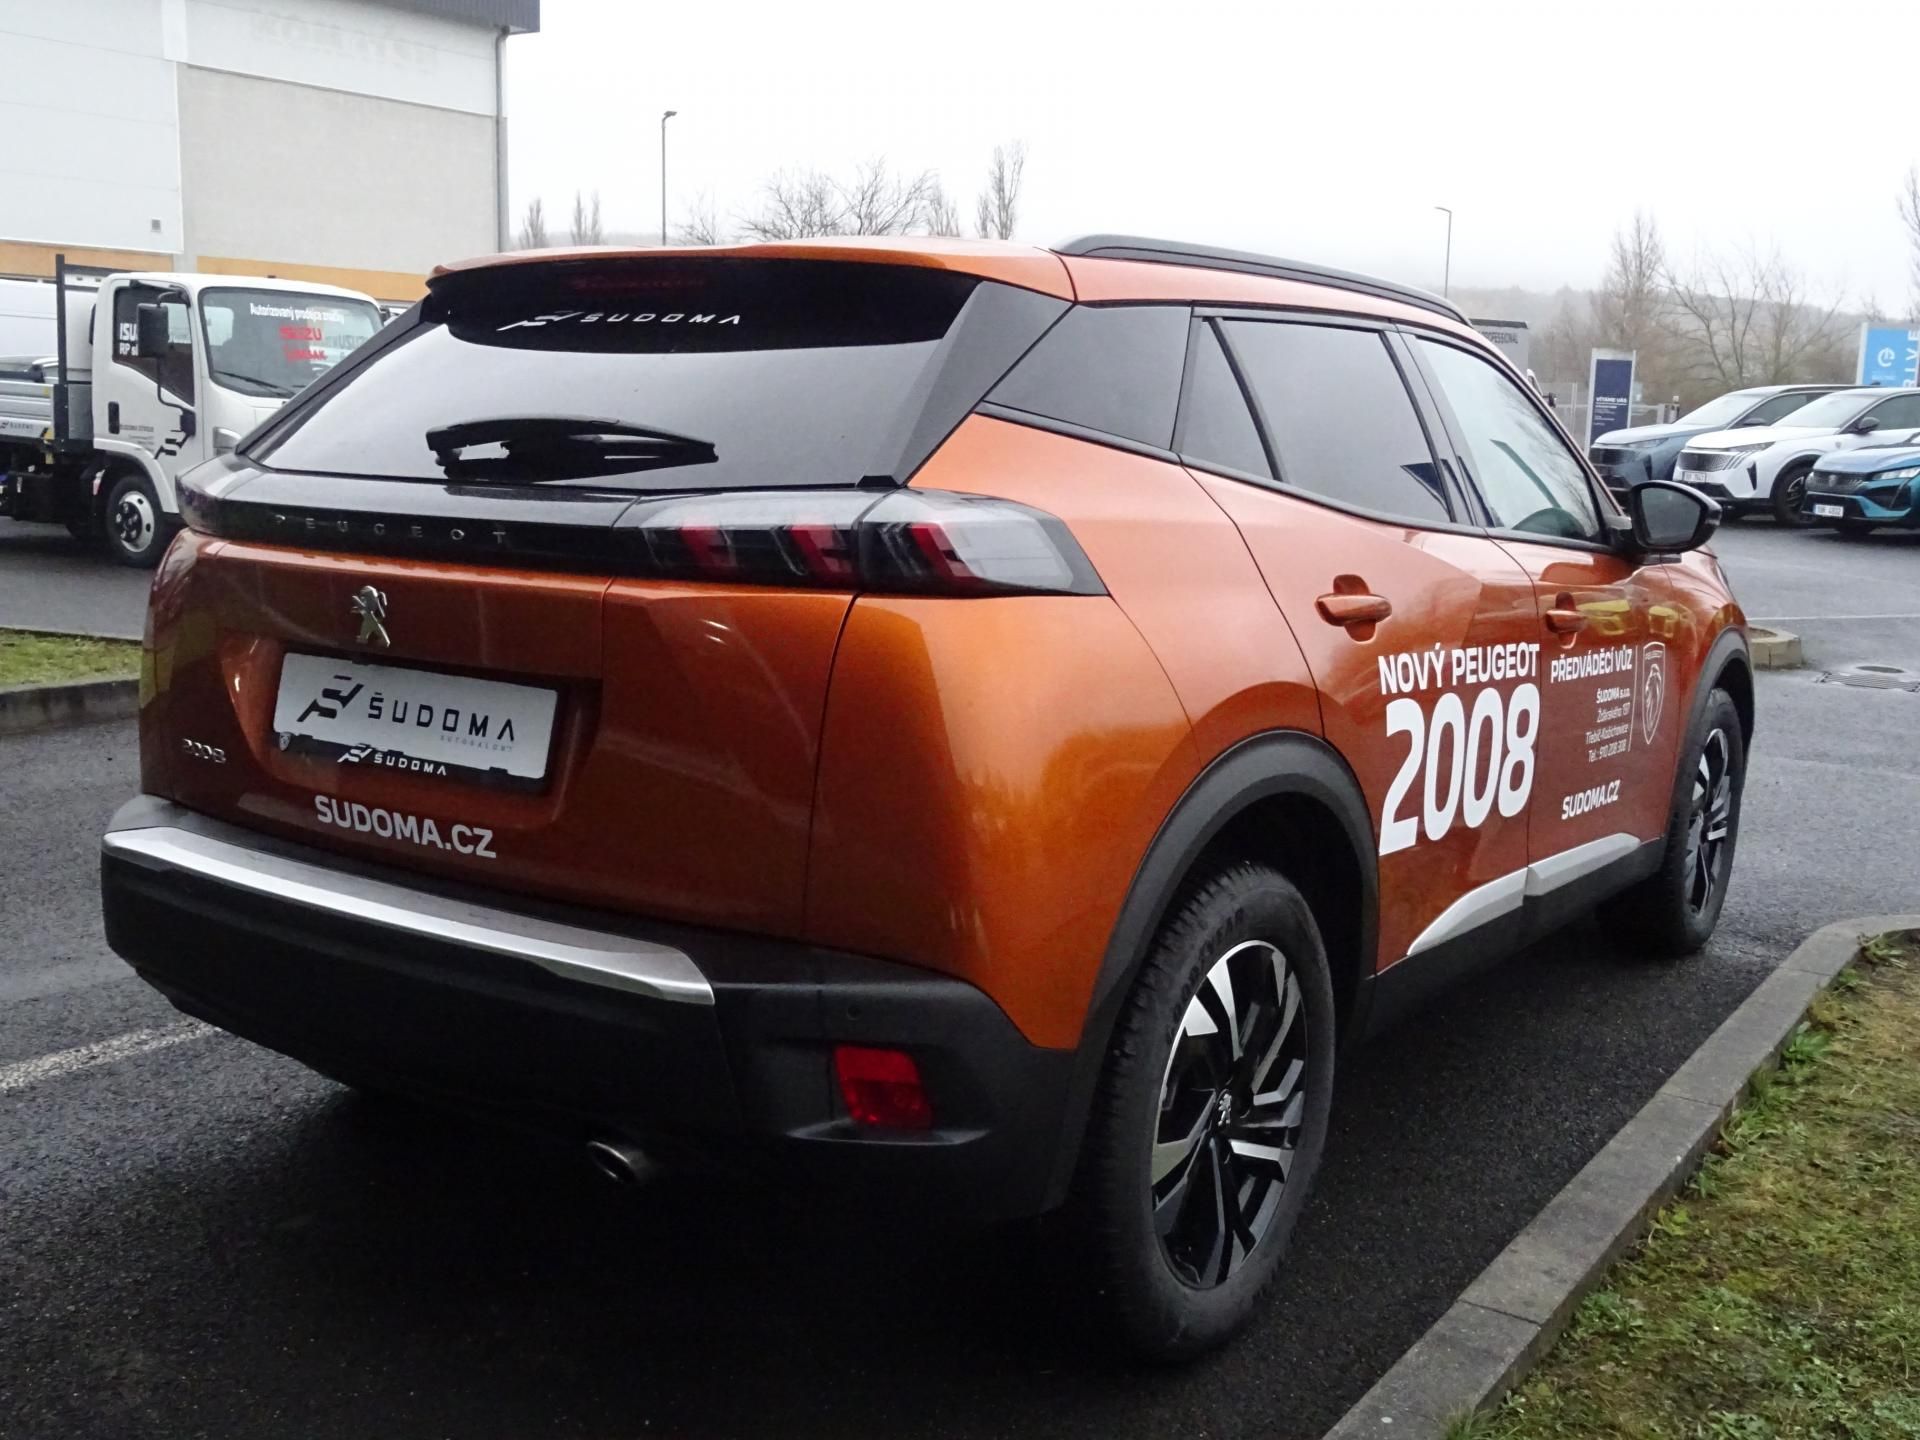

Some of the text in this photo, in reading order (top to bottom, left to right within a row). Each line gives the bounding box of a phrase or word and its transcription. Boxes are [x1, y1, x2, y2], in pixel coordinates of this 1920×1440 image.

[120, 322, 137, 341] ISU
[1378, 641, 1540, 695] NOVÝ PEUGEOT
[1550, 646, 1614, 684] PŘEDVÁDĚCÍ
[1379, 683, 1540, 856] 2008
[1561, 780, 1620, 820] SUDOMA.CZ
[314, 795, 497, 858] SUDOMA.CZ
